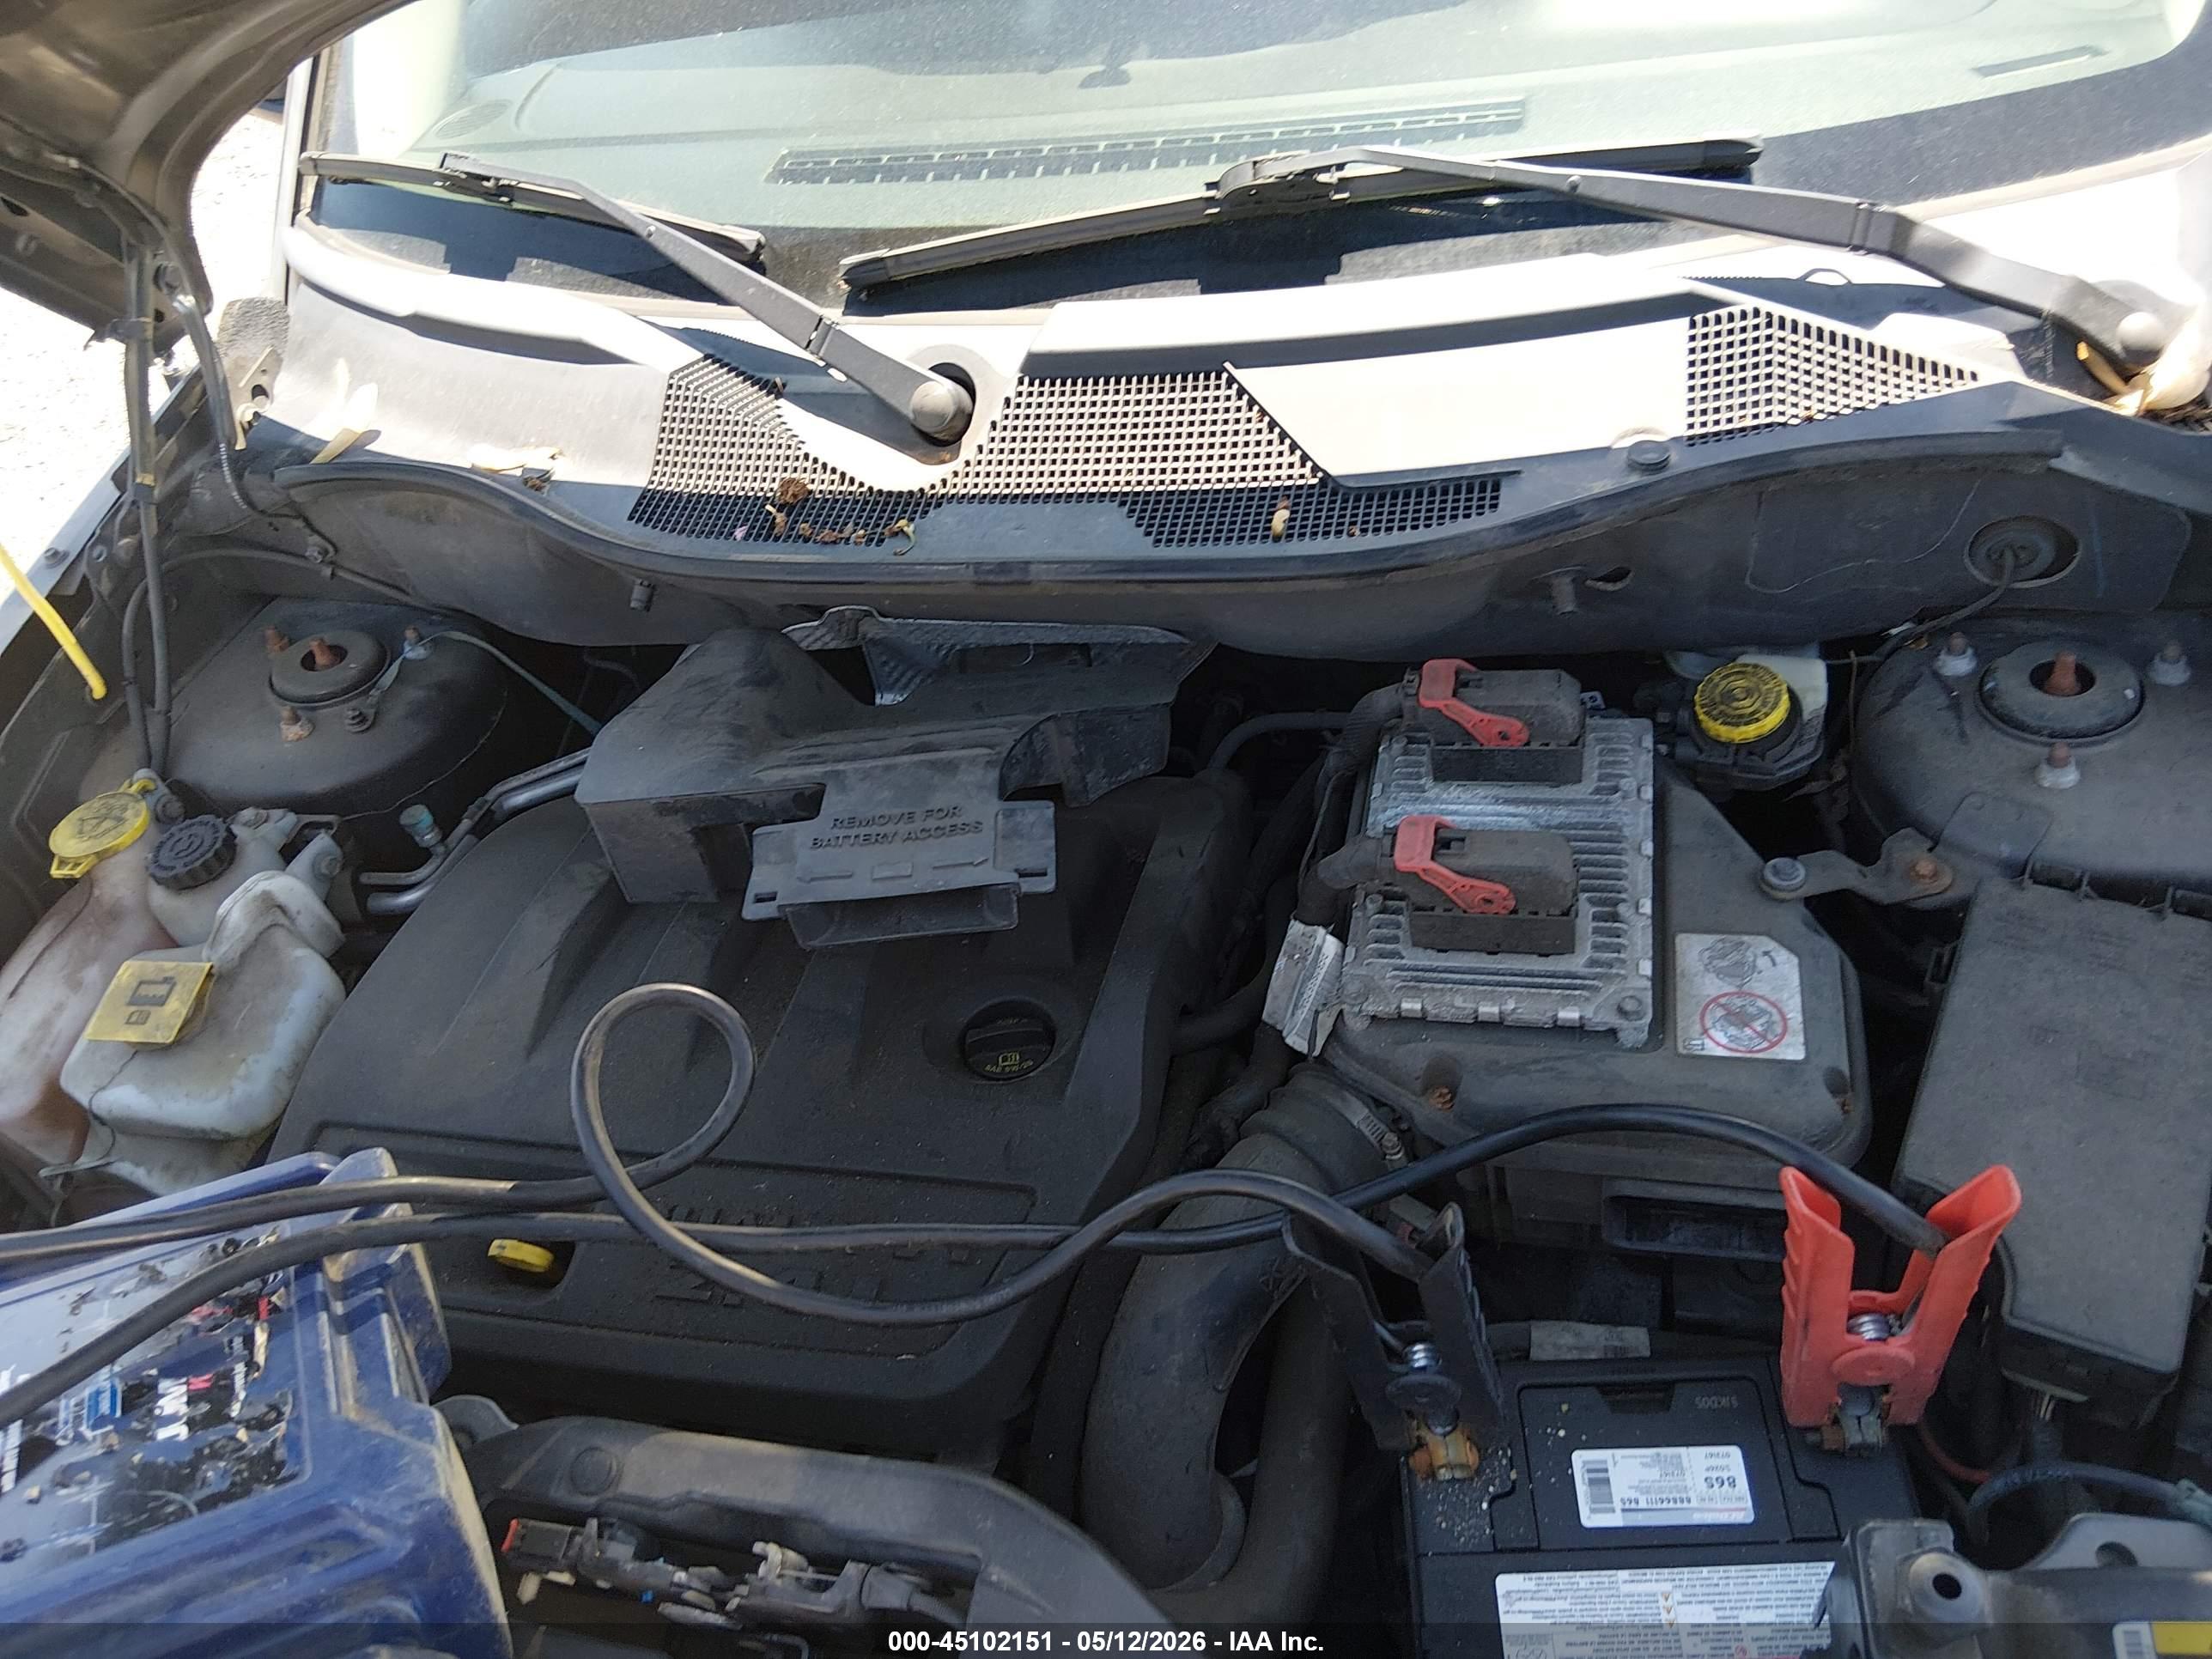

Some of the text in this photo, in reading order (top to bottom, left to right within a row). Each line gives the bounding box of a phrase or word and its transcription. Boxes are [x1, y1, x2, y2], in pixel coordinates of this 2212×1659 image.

[830, 805, 963, 830] REMOVE FOR
[810, 819, 983, 849] BATTERY ACCESS
